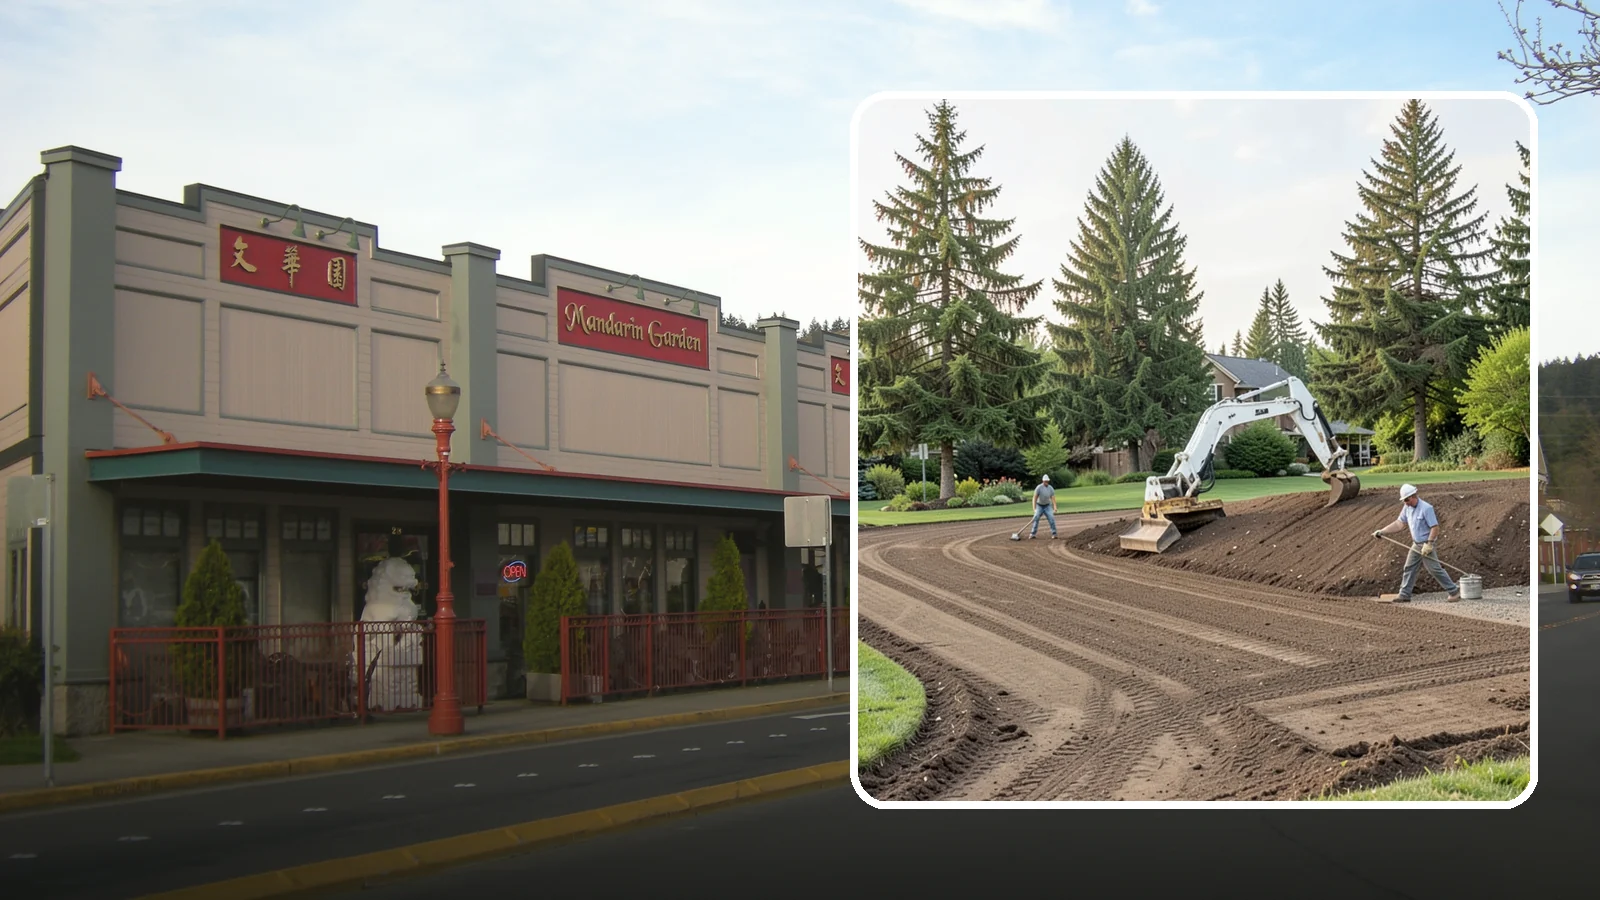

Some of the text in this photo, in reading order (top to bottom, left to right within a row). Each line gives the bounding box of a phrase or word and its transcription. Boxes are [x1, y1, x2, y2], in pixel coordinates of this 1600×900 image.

[230, 235, 347, 291] 文華園
[564, 302, 702, 353] Mandarin Garden
[834, 363, 846, 386] 文
[503, 565, 527, 578] OPEN
